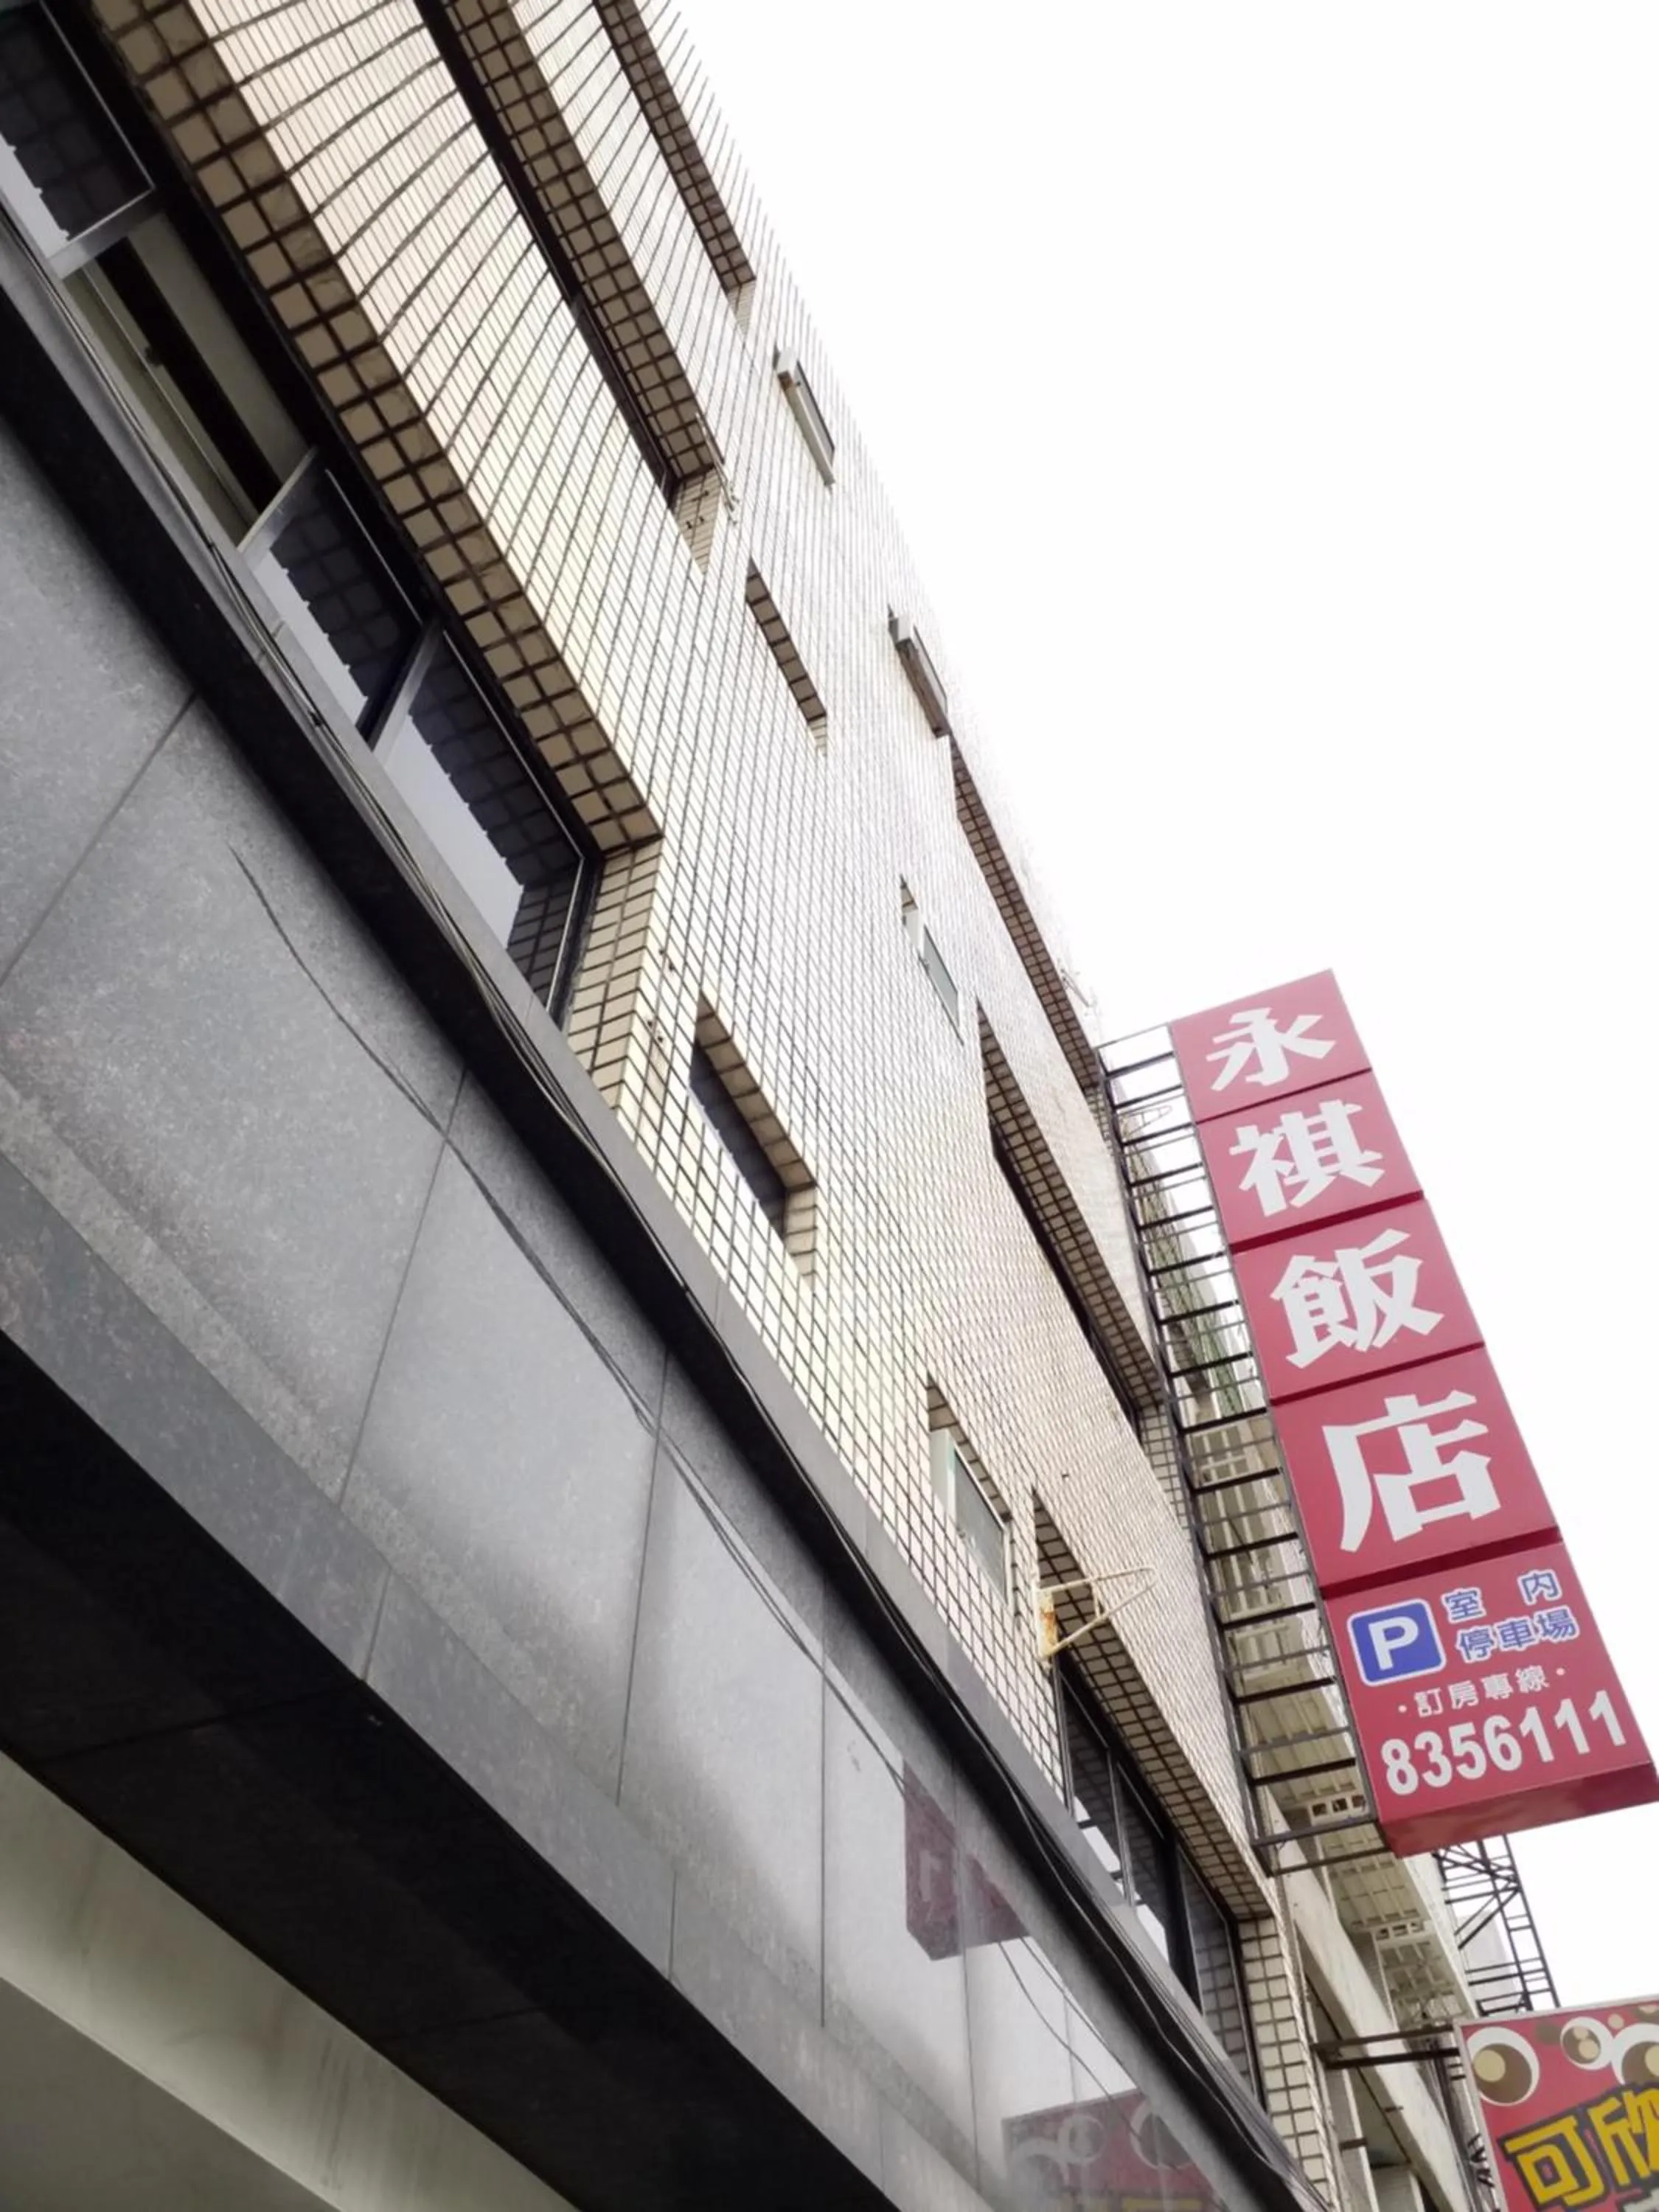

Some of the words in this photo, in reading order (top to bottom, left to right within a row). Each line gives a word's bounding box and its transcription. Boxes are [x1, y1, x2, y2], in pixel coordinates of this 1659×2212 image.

[1206, 1007, 1501, 1552] 永祺飯店
[1368, 1616, 1419, 1670] P
[1455, 1606, 1579, 1664] 停車場
[1381, 1690, 1626, 1795] 8356111
